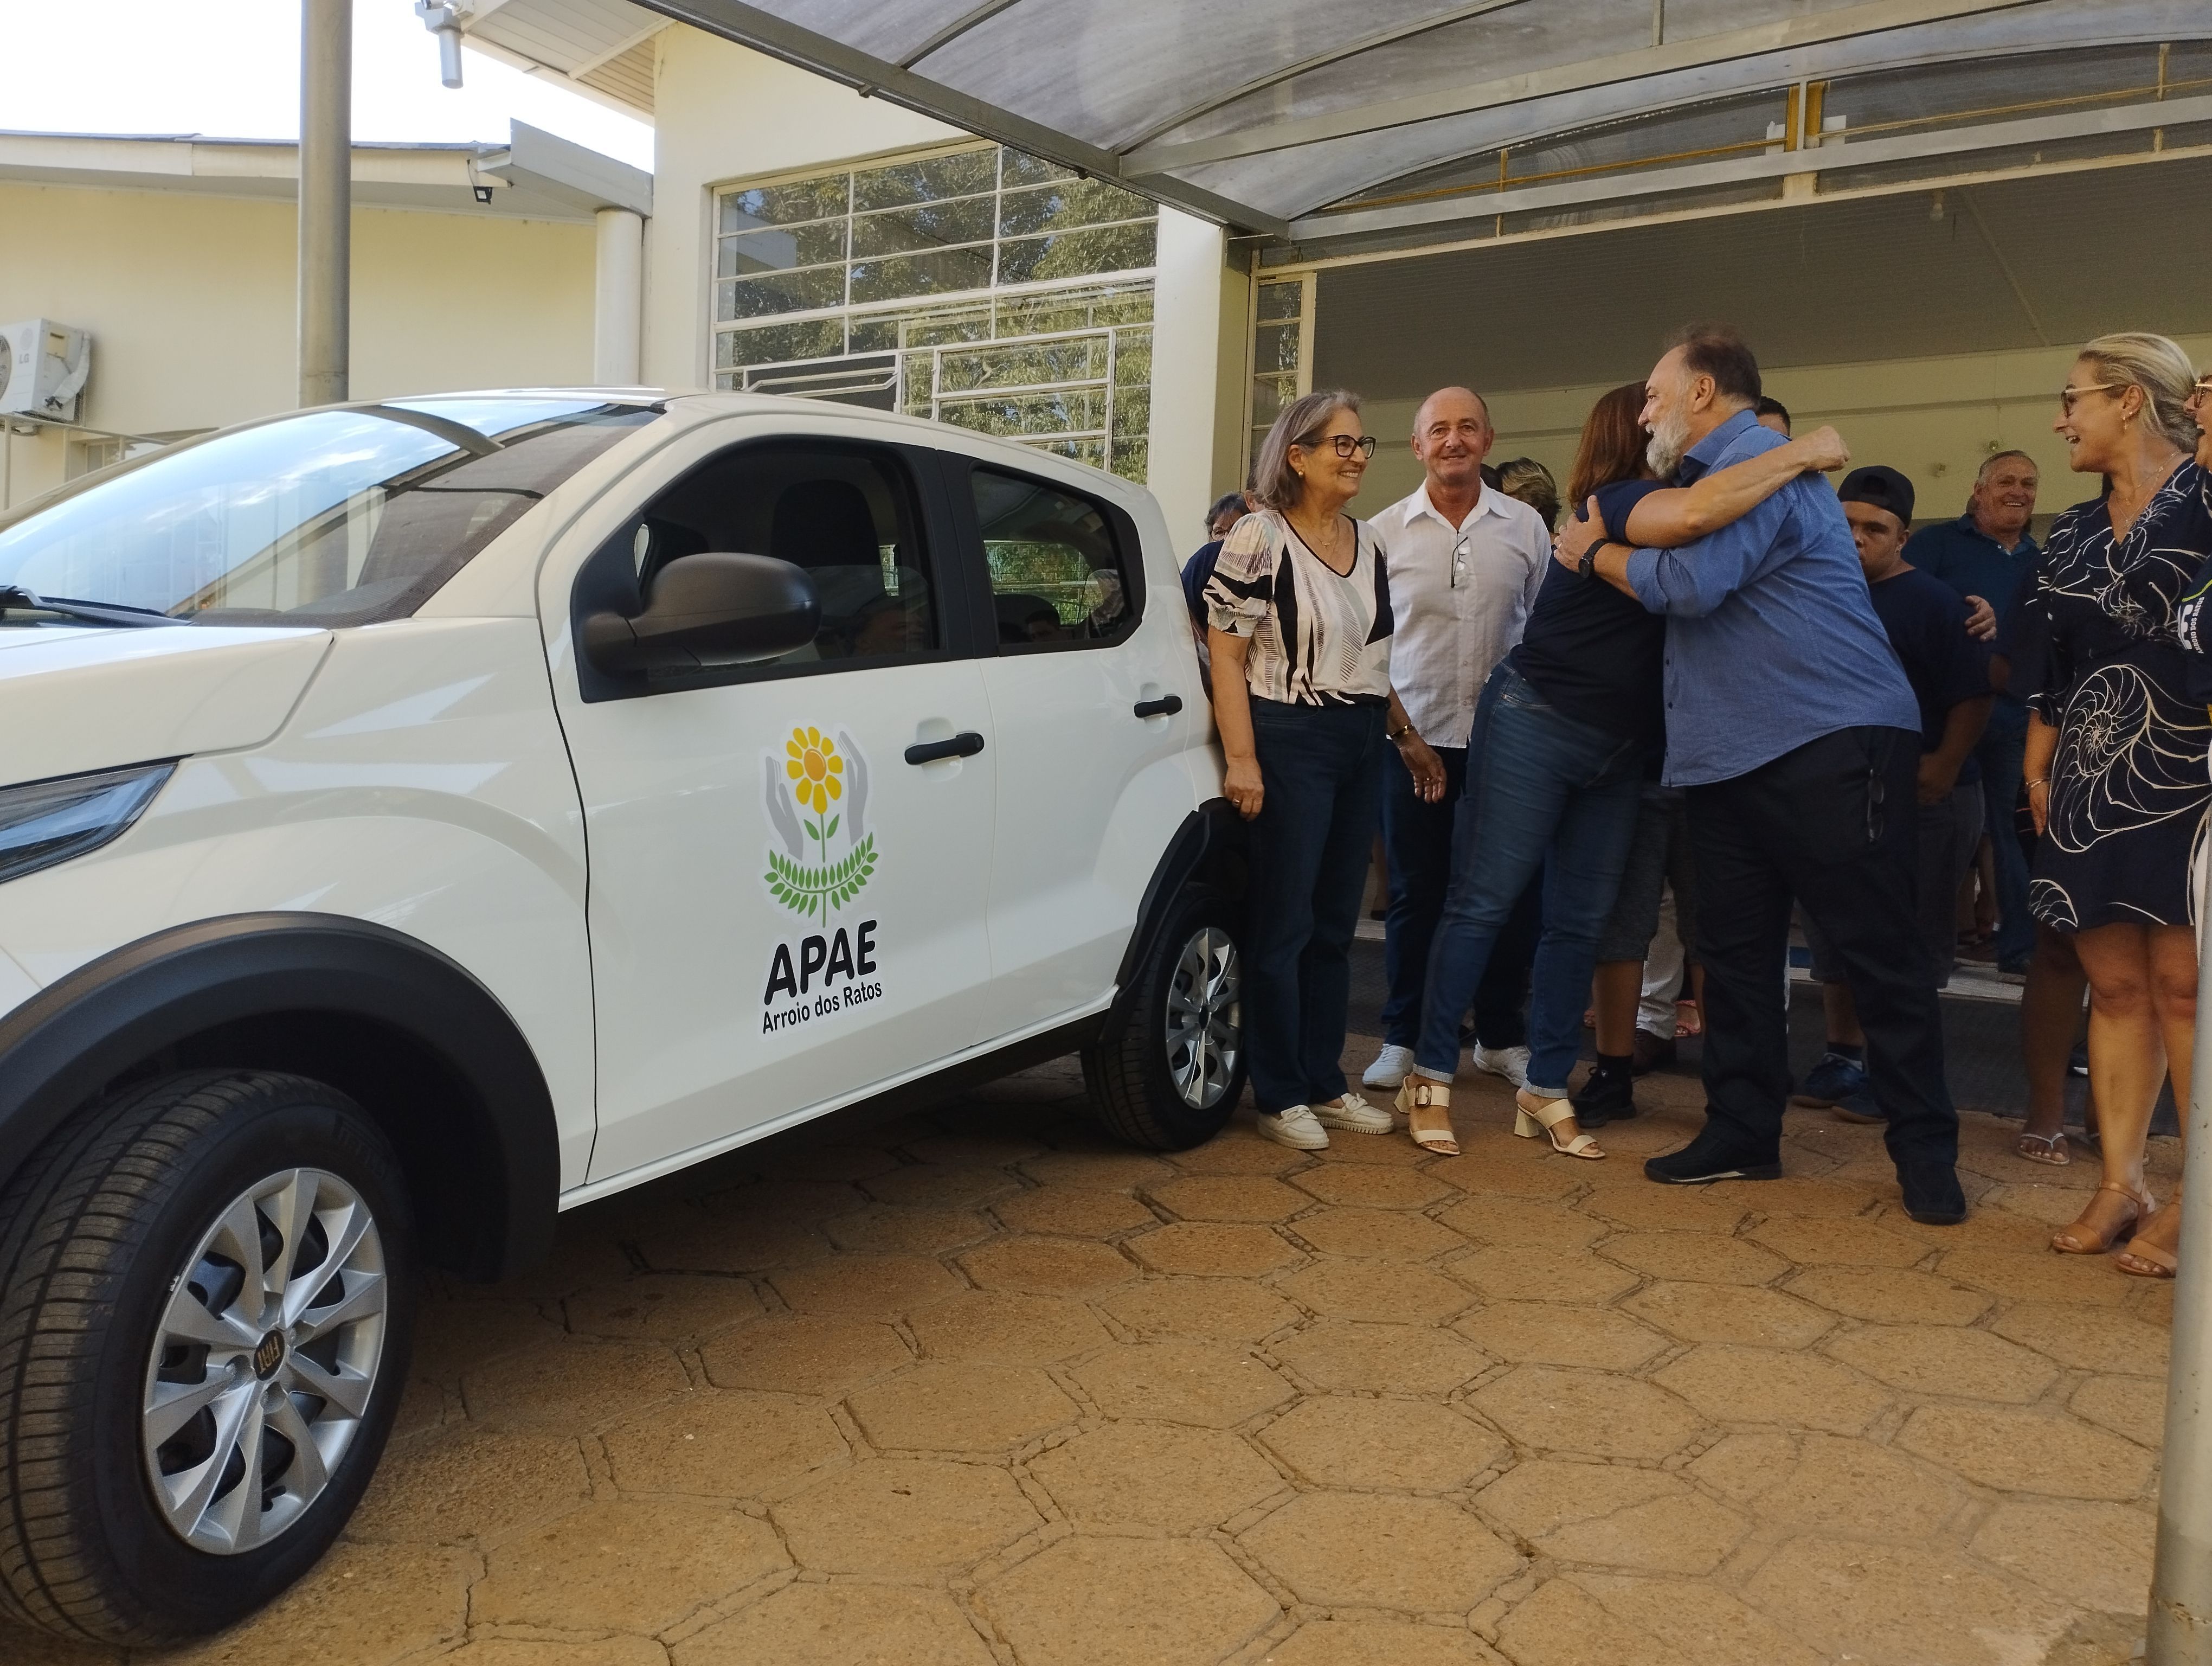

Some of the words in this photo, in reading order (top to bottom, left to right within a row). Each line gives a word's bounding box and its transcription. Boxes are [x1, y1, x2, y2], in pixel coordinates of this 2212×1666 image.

[18, 353, 30, 364] LG
[2192, 597, 2204, 616] RATOS
[764, 919, 877, 1005] APAE
[763, 1002, 810, 1034] Arroio
[814, 995, 840, 1017] dos
[843, 981, 882, 1008] Ratos
[258, 1336, 280, 1374] FIAT
